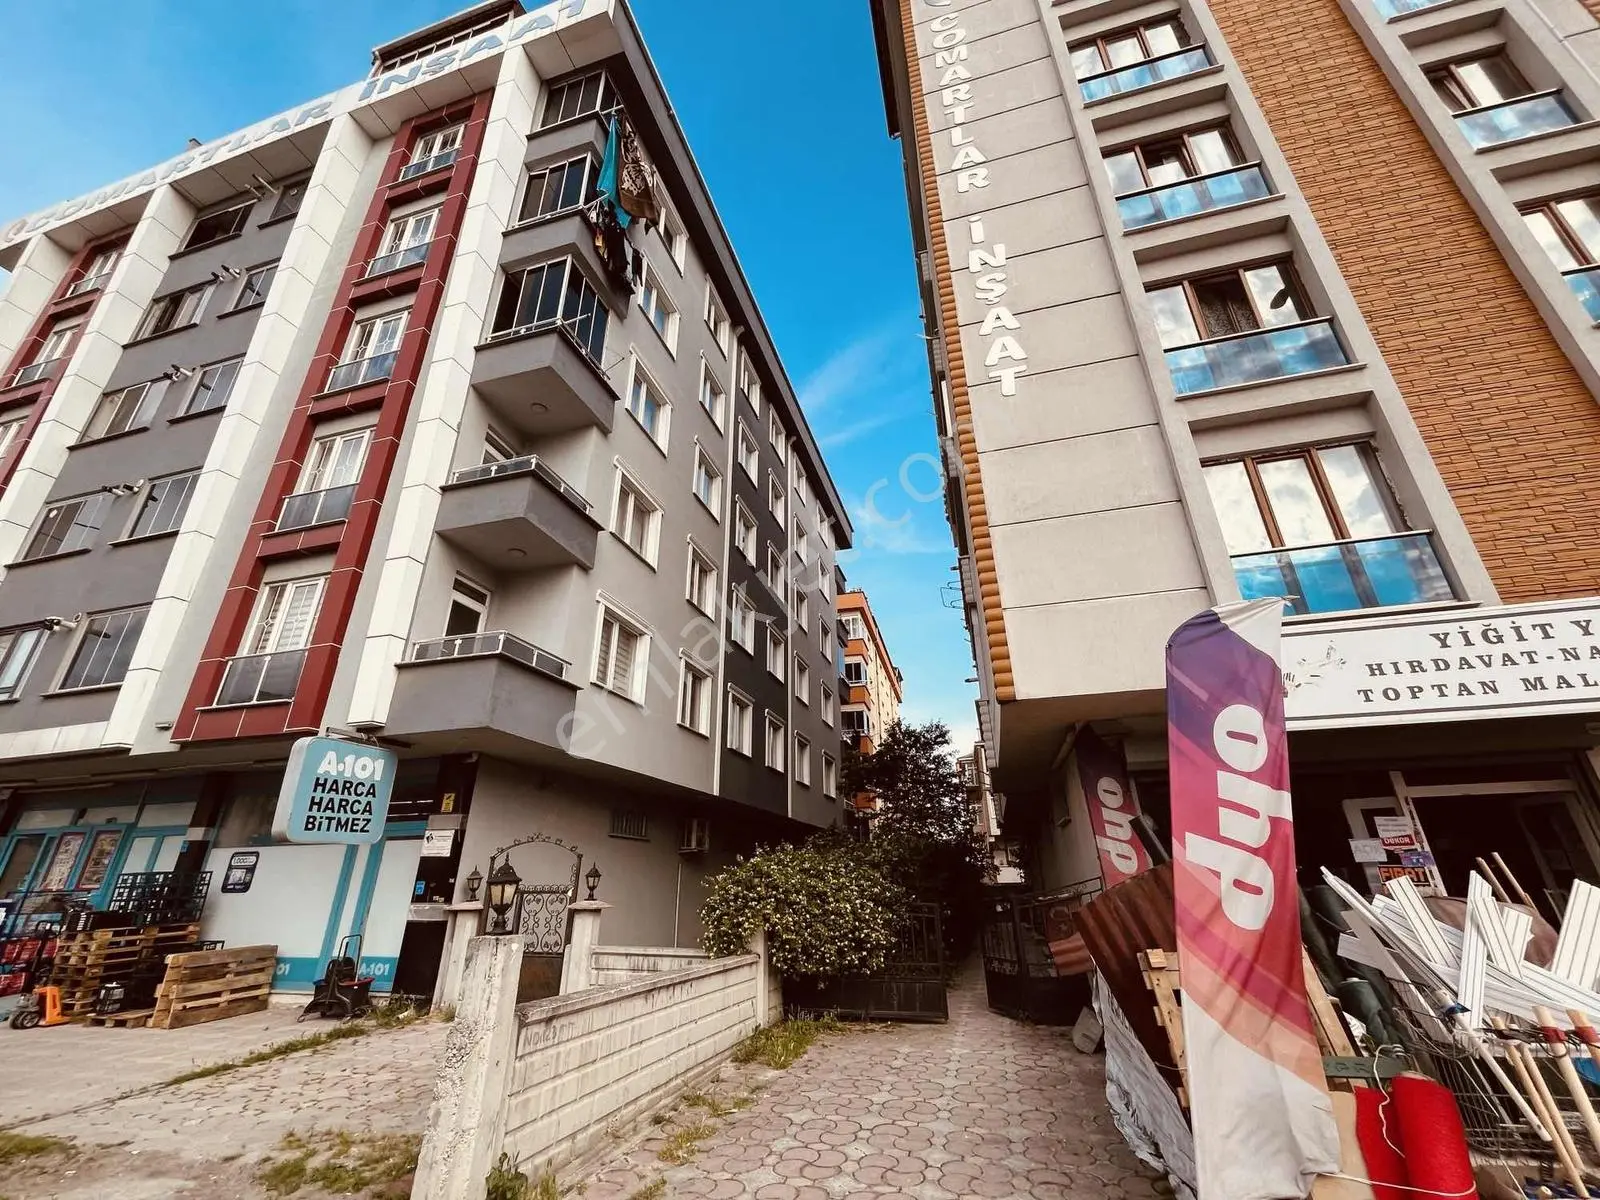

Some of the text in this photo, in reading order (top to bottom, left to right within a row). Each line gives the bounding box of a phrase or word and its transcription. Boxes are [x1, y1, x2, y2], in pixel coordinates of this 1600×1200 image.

[968, 215, 1028, 397] İNŞAAT
[1430, 622, 1555, 648] YİĞİT
[1357, 679, 1500, 703] TOPTAN
[312, 777, 377, 799] HARCA
[308, 796, 373, 816] HARCA
[1184, 704, 1293, 930] dyo
[1096, 776, 1138, 874] dyo
